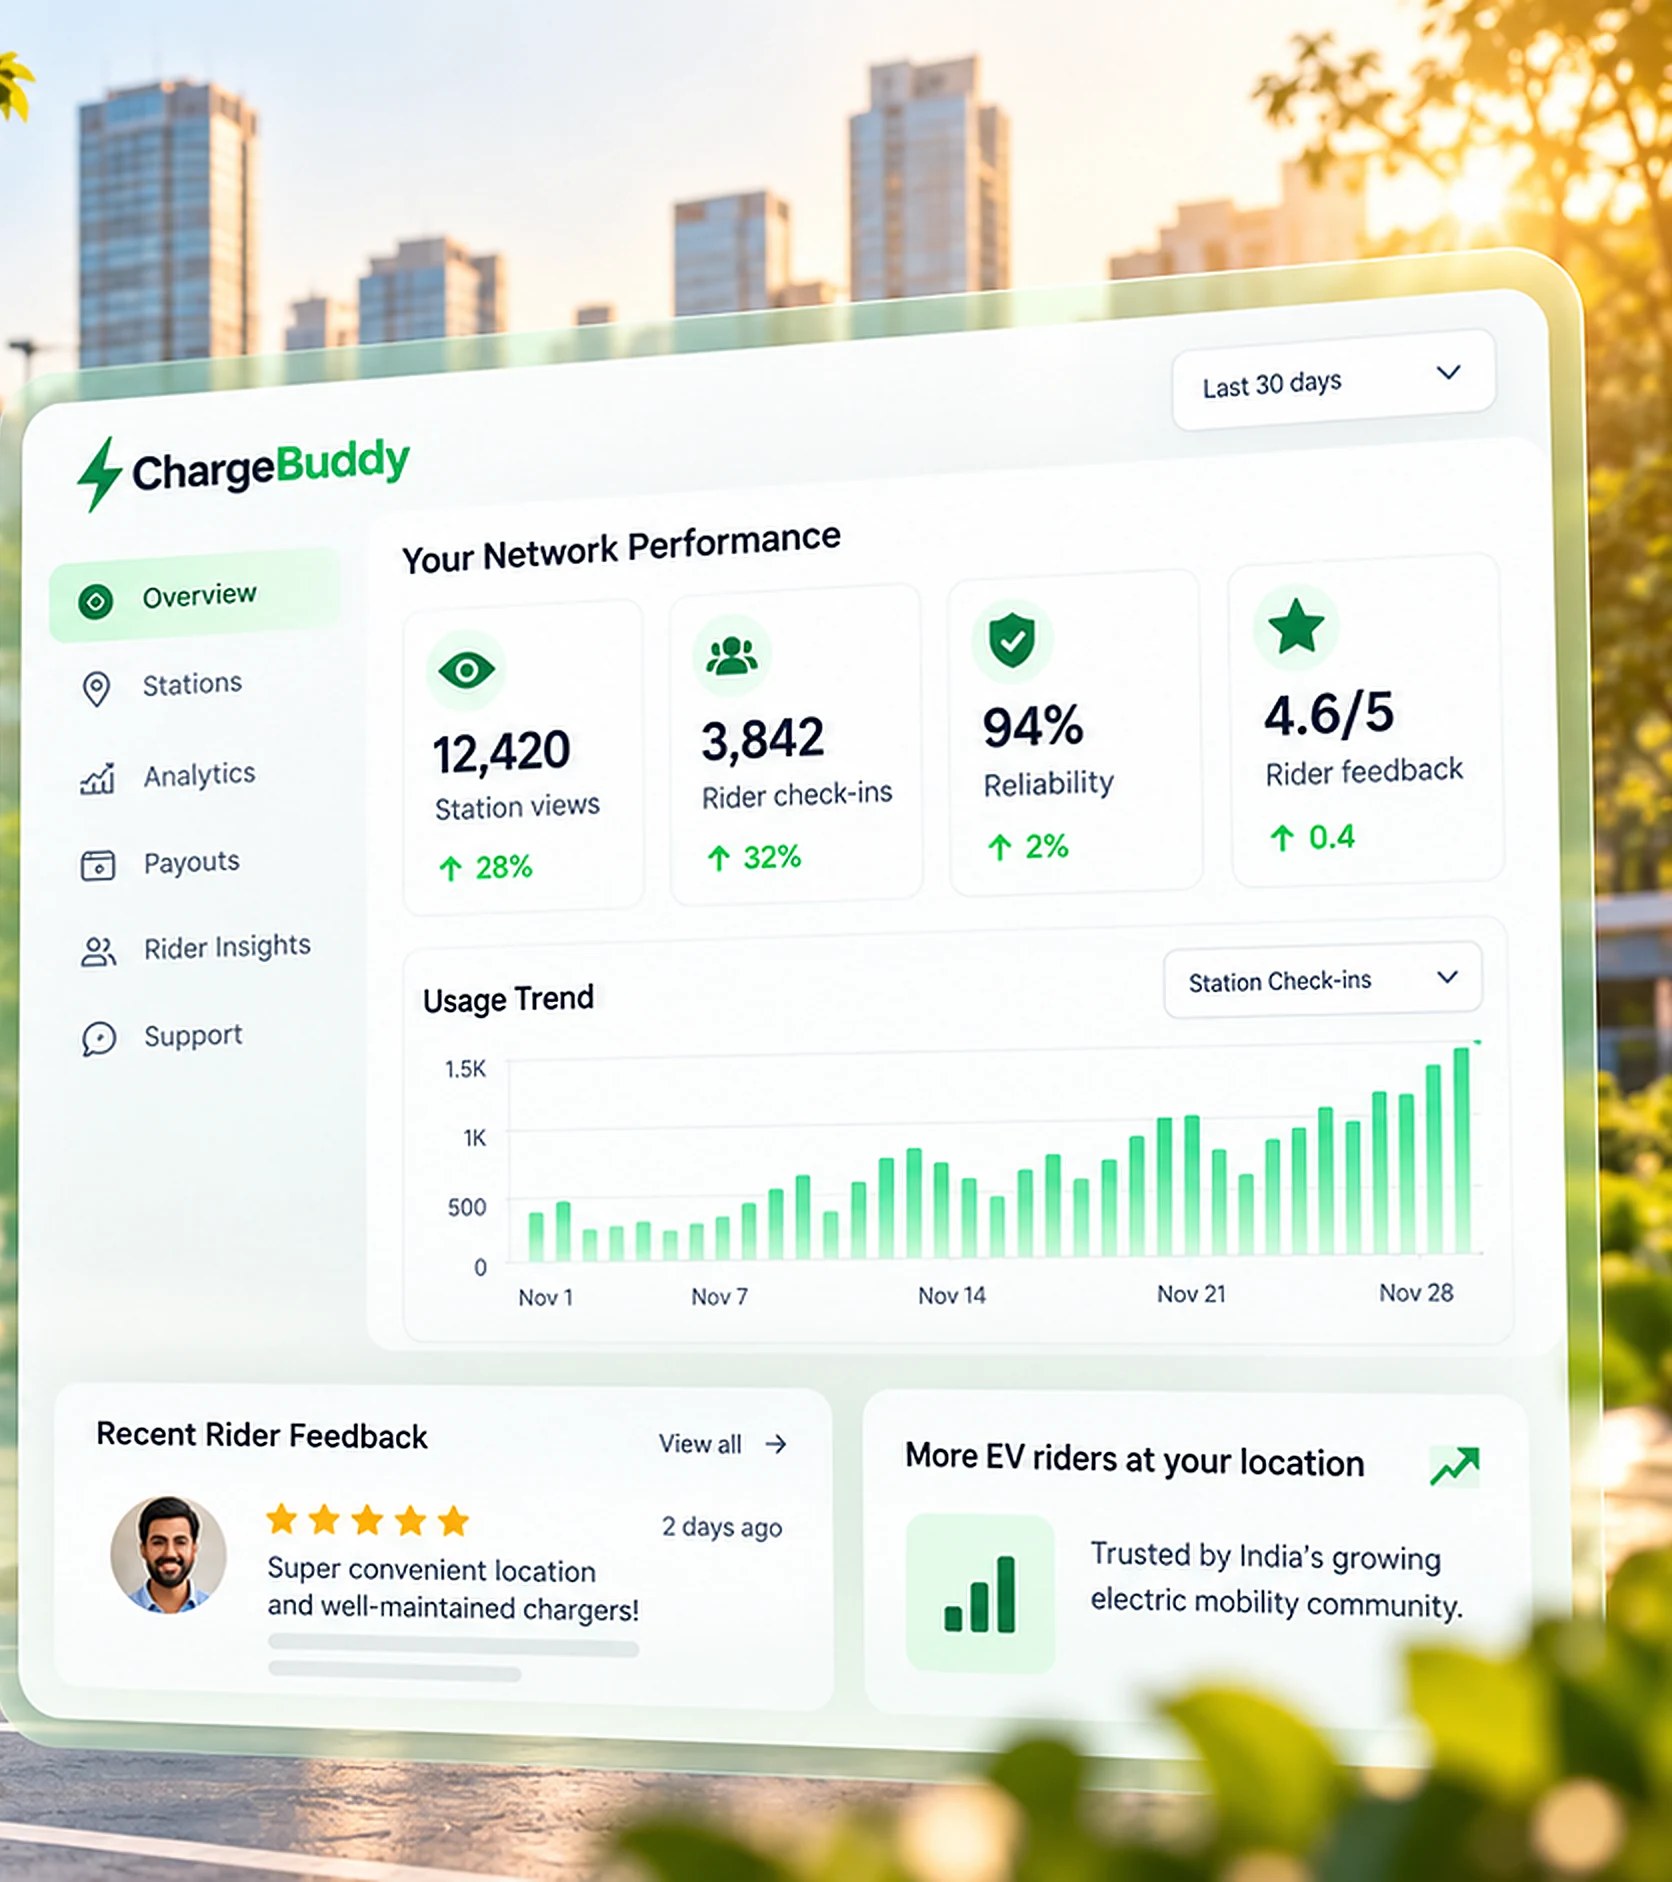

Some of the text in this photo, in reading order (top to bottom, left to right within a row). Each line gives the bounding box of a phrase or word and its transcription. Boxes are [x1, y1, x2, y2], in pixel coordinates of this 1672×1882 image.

[1203, 371, 1343, 399] Last 30 days
[132, 437, 411, 495] ChargeBuddy
[402, 526, 841, 575] Your Network Performance
[143, 582, 257, 610] Overview
[143, 671, 243, 697] Stations
[983, 703, 1084, 749] 94%
[1264, 688, 1394, 742] 4.6/5
[433, 729, 571, 780] 12,420
[702, 715, 825, 768] 3,842
[143, 761, 256, 792] Analytics
[984, 769, 1115, 800] Reliability
[1267, 755, 1464, 787] Rider feedback
[435, 793, 601, 821] Station views
[703, 779, 893, 810] Rider check-ins
[1026, 833, 1070, 859] 2%
[1309, 823, 1356, 851] 0.4
[145, 851, 241, 879] Payouts
[475, 853, 534, 880] 28%
[743, 843, 802, 870] 32%
[145, 933, 312, 963] Rider Insights
[1189, 969, 1372, 994] Station Check-ins
[423, 982, 594, 1019] Usage Trend
[145, 1024, 243, 1052] Support
[445, 1059, 487, 1079] 1.5K
[463, 1128, 487, 1147] 1K
[448, 1197, 487, 1218] 500
[474, 1257, 488, 1277] 0
[519, 1287, 573, 1307] Nov 1
[691, 1287, 749, 1307] Nov 7
[919, 1285, 987, 1305] Nov 14
[1157, 1283, 1225, 1304] Nov 21
[1379, 1282, 1455, 1303] Nov 28
[97, 1420, 429, 1450] Recent Rider Feedback
[658, 1432, 742, 1455] View all
[906, 1440, 1365, 1481] More EV riders at your location
[662, 1515, 783, 1543] 2 days ago
[268, 1555, 596, 1585] Super convenient location
[1090, 1540, 1191, 1567] Trusted
[1200, 1542, 1232, 1574] by
[1332, 1546, 1441, 1578] growing
[267, 1593, 639, 1628] and well-maintained chargers!
[1091, 1585, 1463, 1625] electric mobility community.
